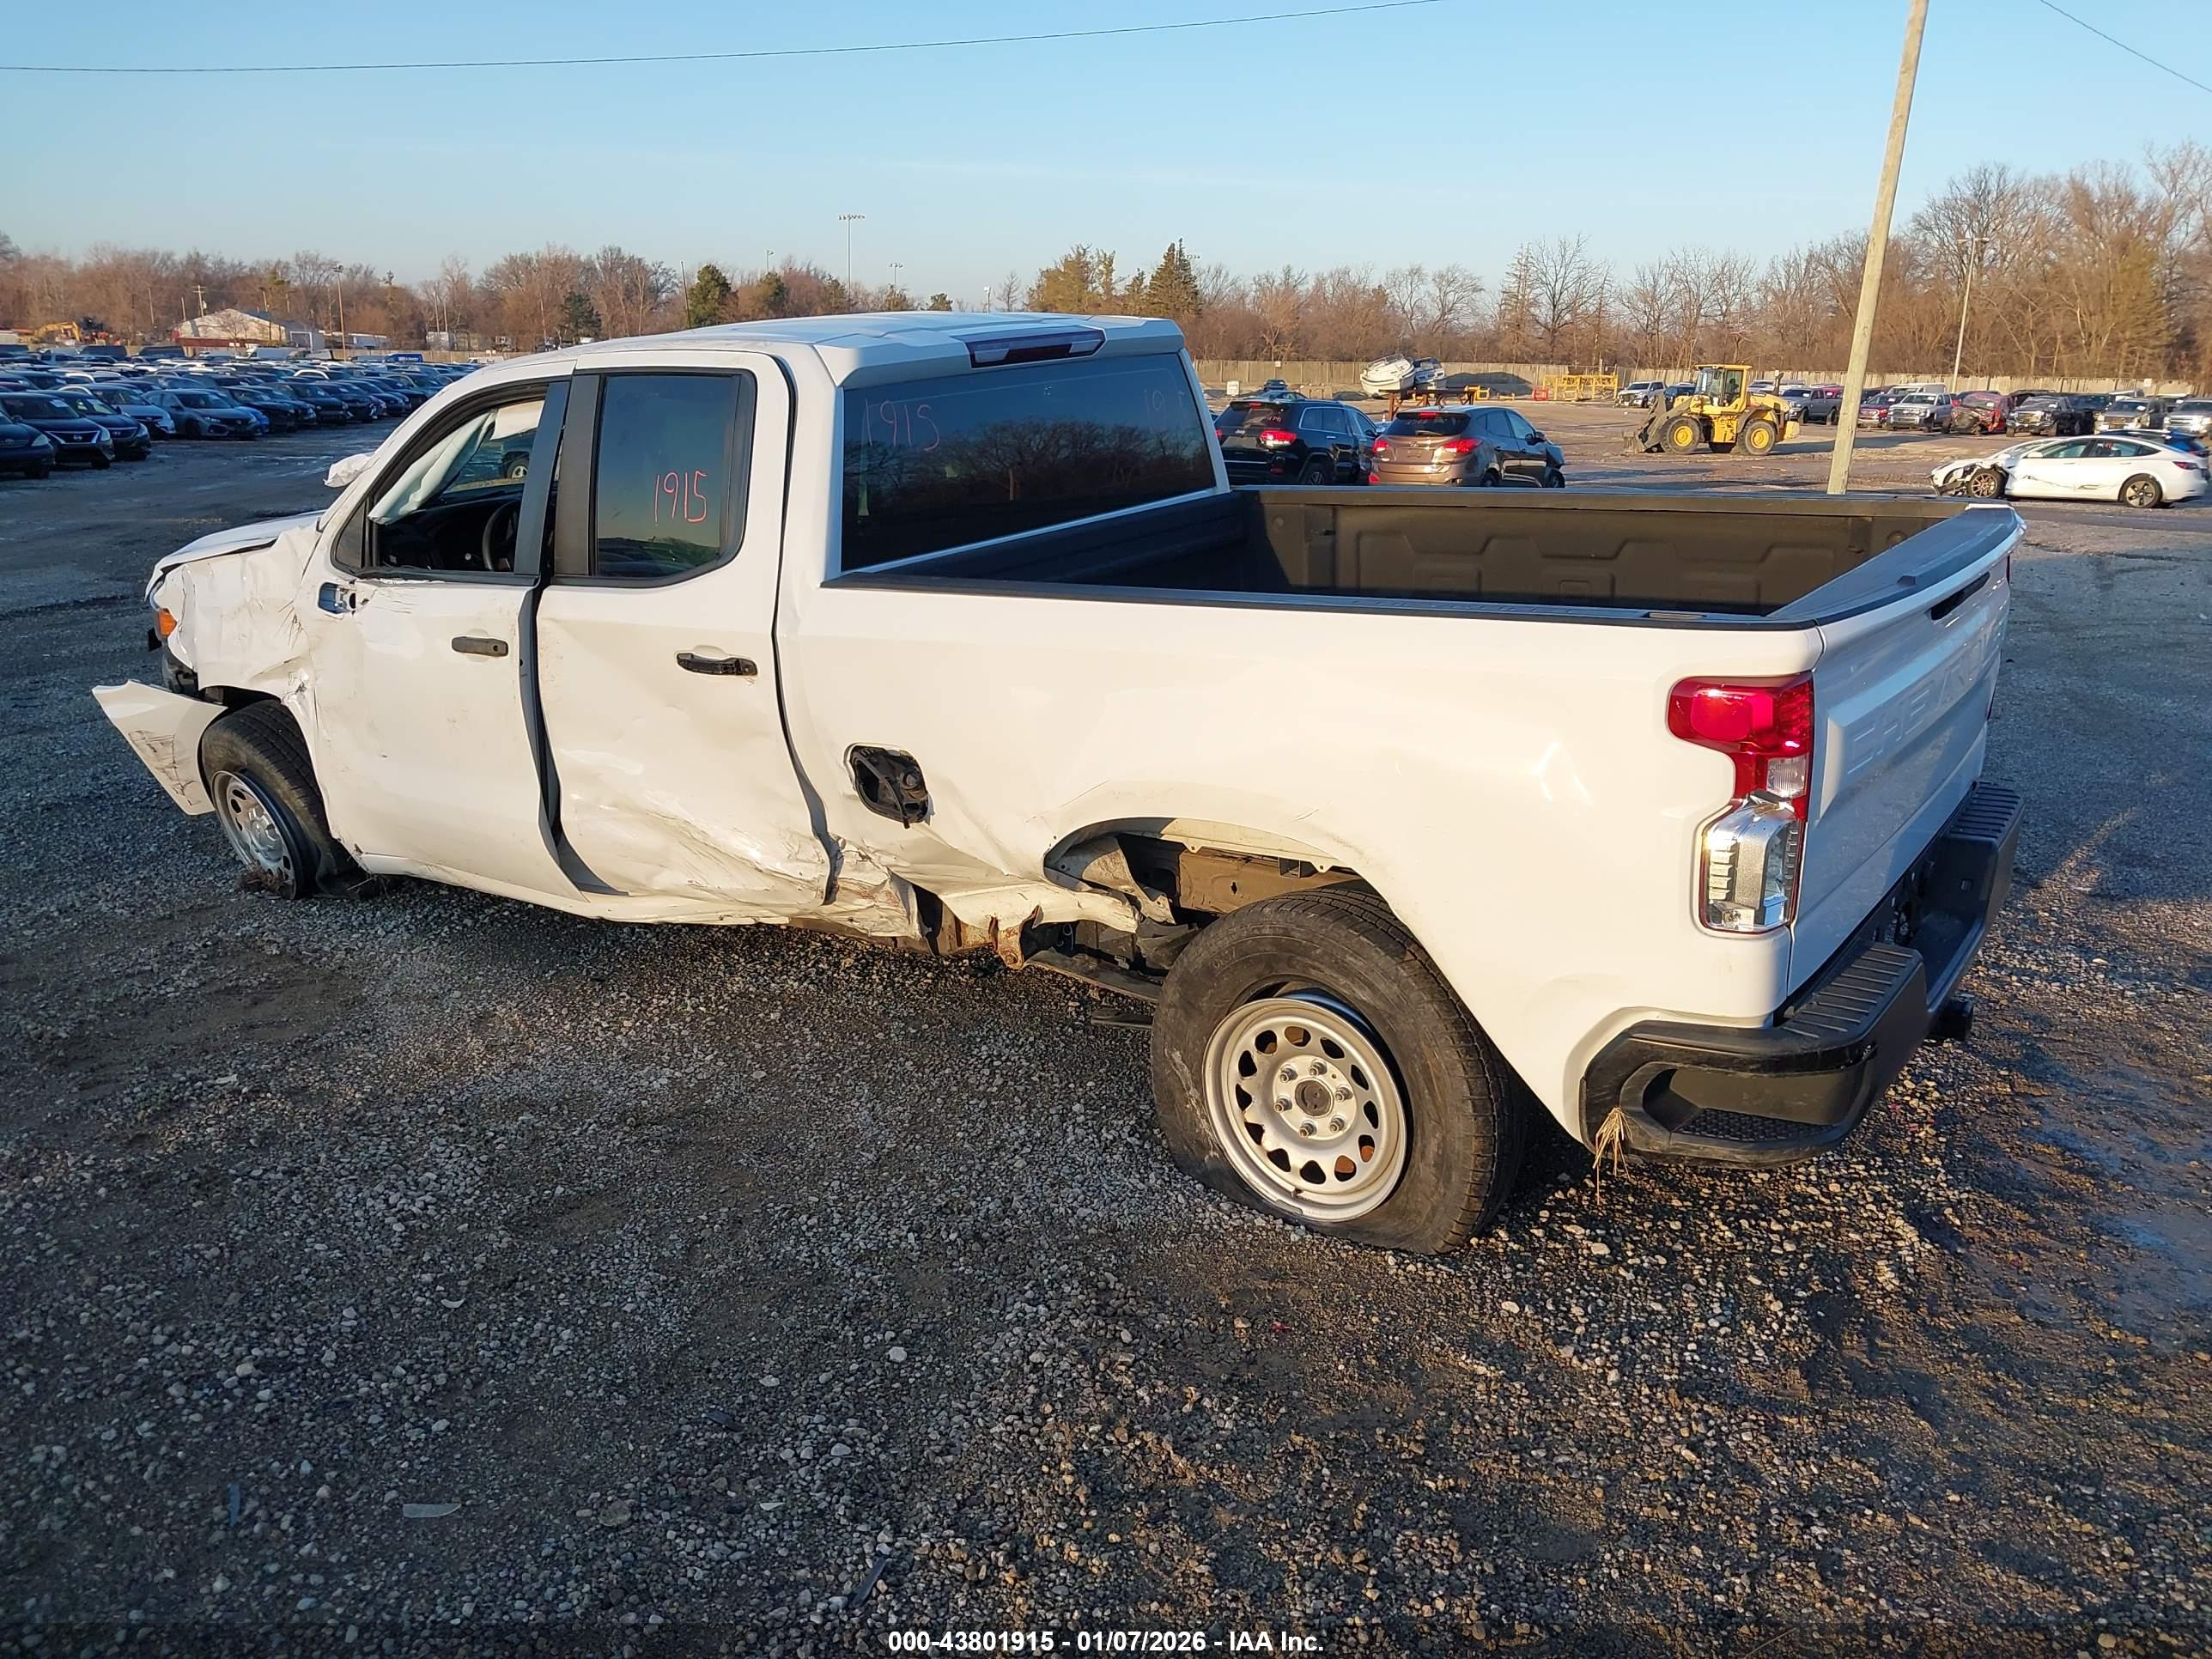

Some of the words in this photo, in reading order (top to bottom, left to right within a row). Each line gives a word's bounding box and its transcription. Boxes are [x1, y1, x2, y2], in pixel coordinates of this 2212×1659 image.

[864, 398, 940, 452] 1915
[654, 470, 708, 523] 1915
[1847, 617, 2002, 774] CHEVRL
